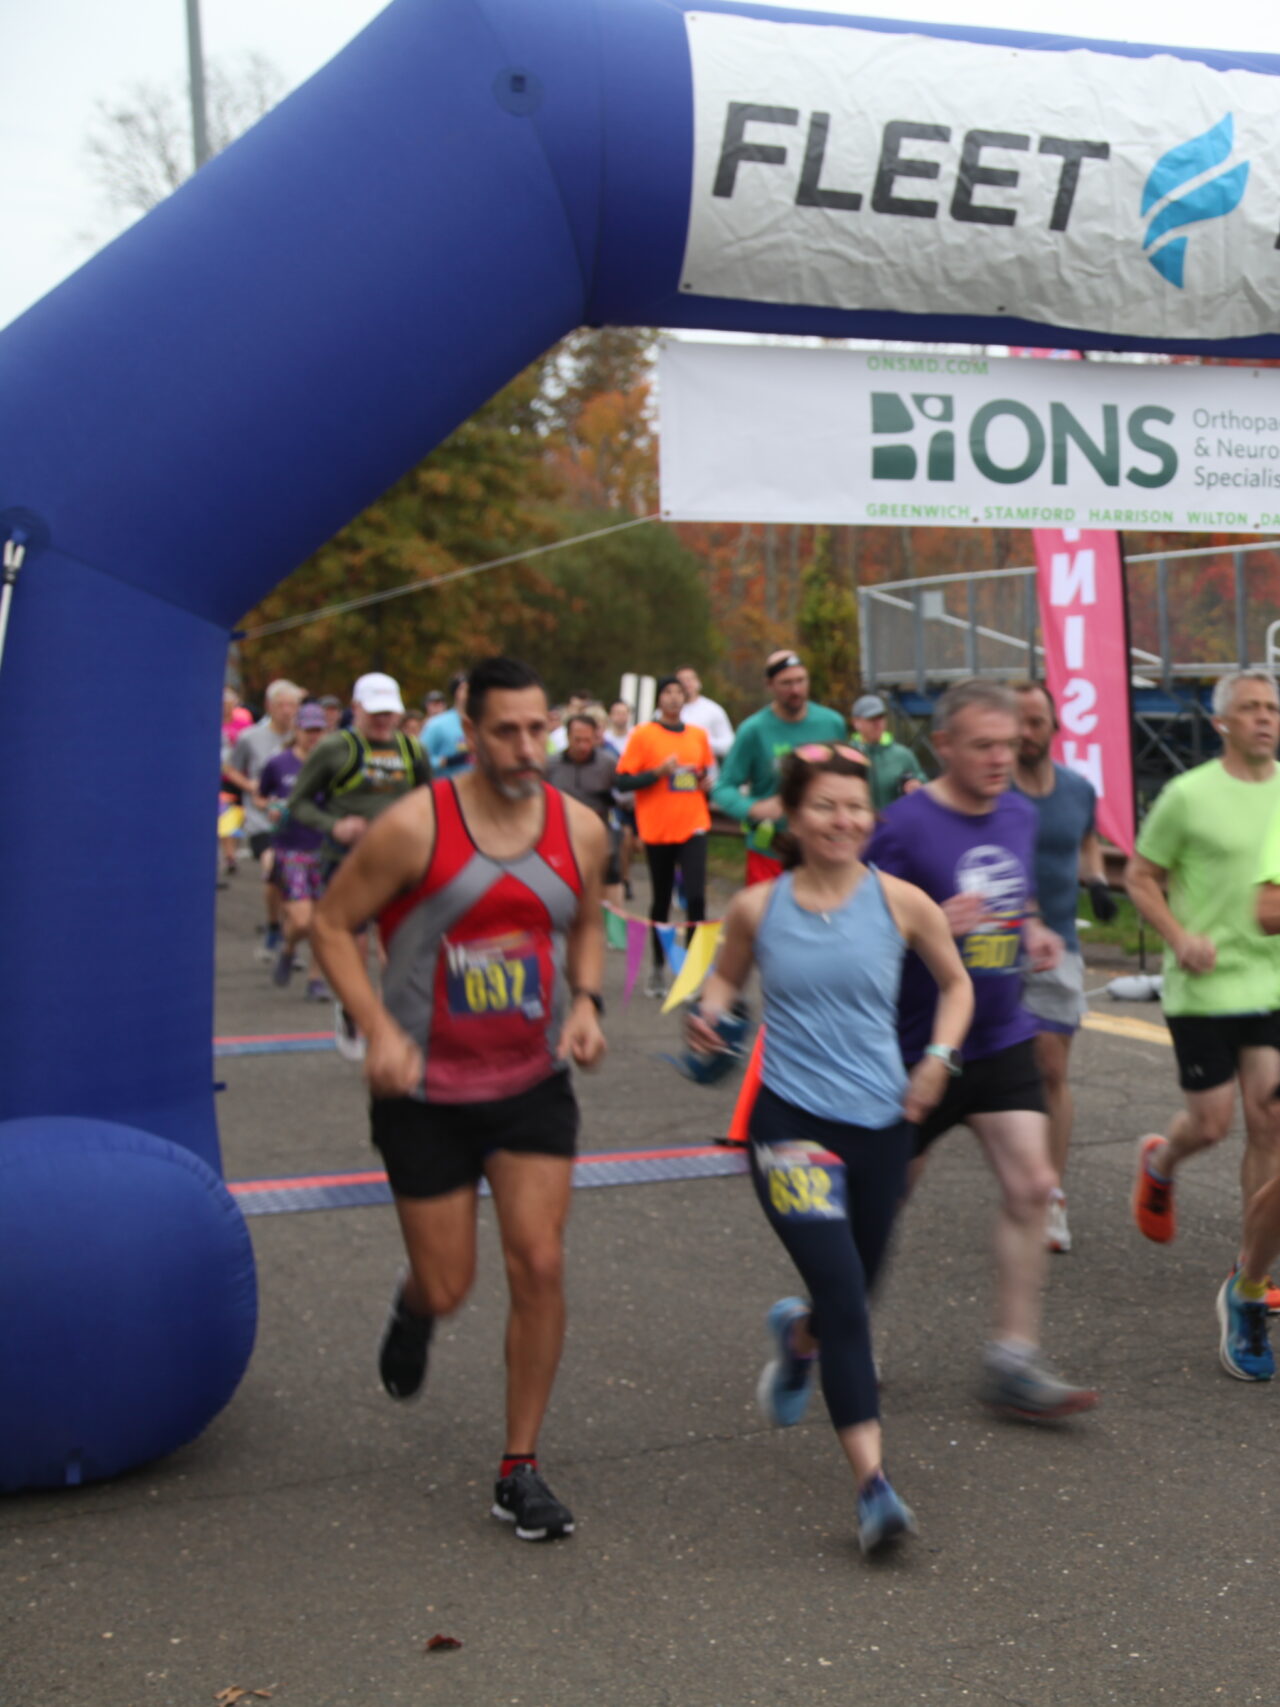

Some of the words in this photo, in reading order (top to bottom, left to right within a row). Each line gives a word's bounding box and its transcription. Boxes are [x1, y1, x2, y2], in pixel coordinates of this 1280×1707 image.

[711, 101, 1110, 232] FLEET
[867, 355, 989, 376] ONSMD.COM
[969, 398, 1179, 489] ONS
[1193, 436, 1210, 458] &
[866, 503, 971, 520] GREENWICH
[983, 506, 1076, 522] STAMFORD
[1088, 509, 1174, 524] HARRISON
[1186, 511, 1248, 526] WILTON
